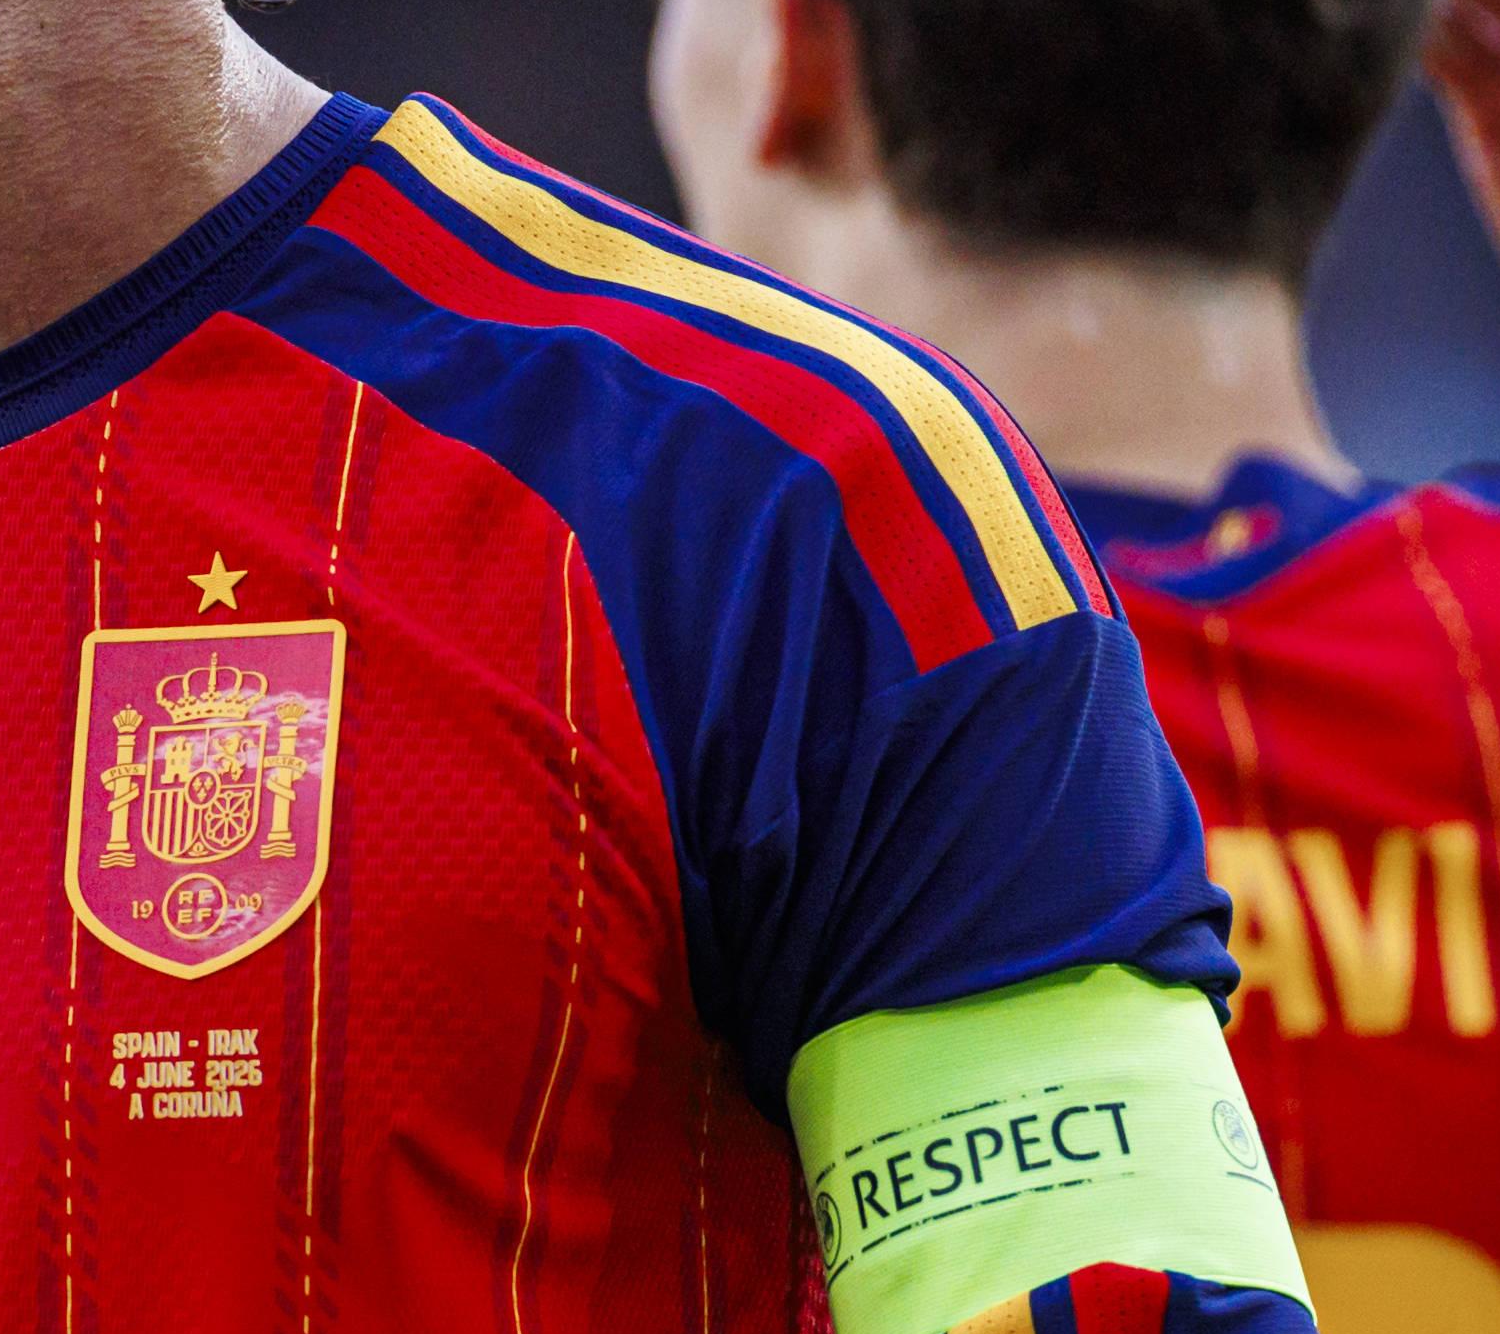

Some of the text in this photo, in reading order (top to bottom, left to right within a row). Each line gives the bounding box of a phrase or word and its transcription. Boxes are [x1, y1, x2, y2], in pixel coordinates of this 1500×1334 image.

[131, 899, 154, 919] 19
[1168, 824, 1496, 1038] AVI
[112, 1031, 180, 1059] SPAIN
[207, 1029, 259, 1056] IRAK
[109, 1059, 263, 1089] 4 JUNE 2026
[128, 1082, 243, 1120] A CORUÑA
[851, 1101, 1132, 1230] RESPECT
